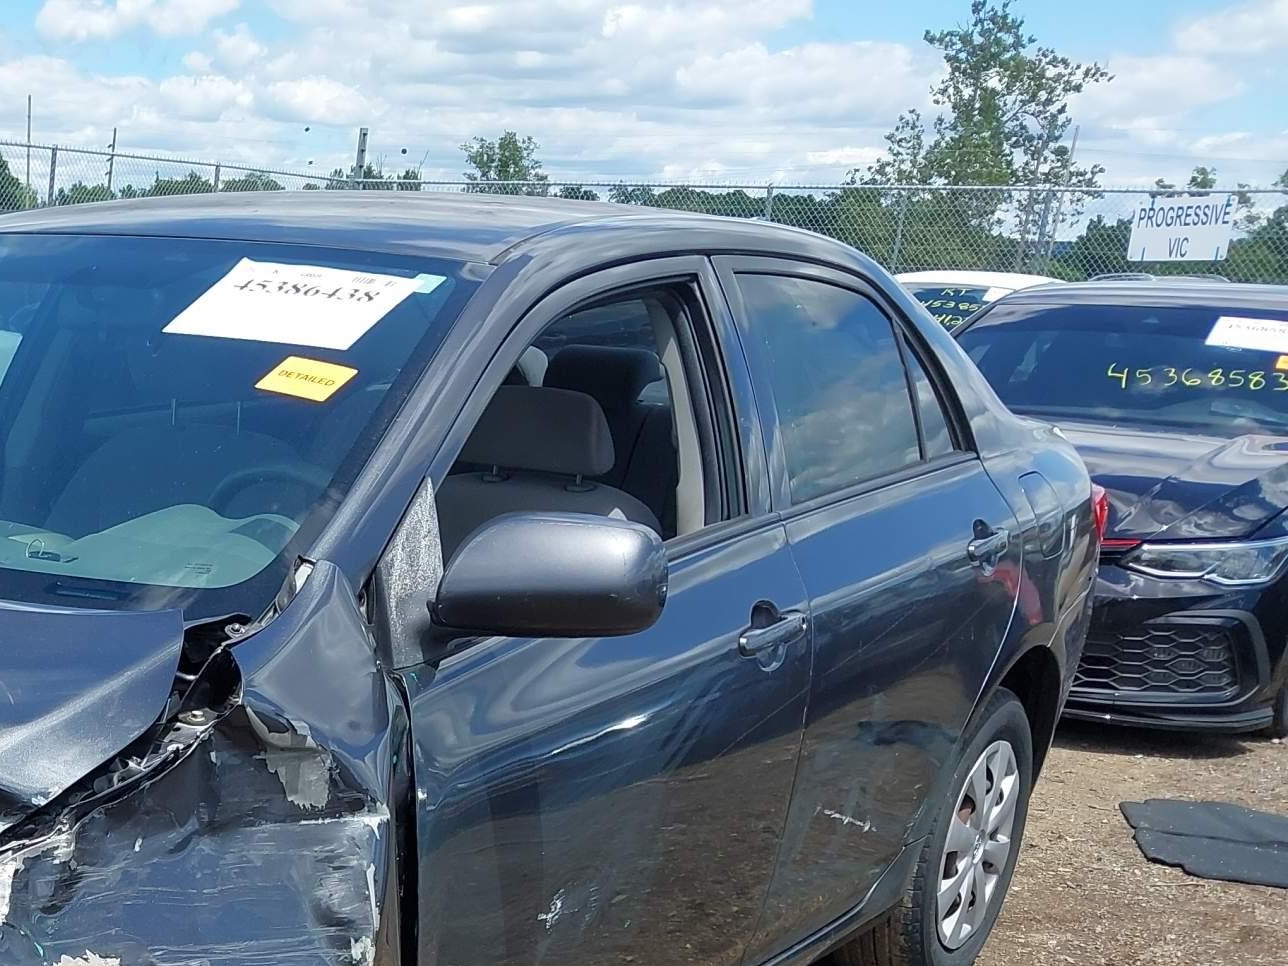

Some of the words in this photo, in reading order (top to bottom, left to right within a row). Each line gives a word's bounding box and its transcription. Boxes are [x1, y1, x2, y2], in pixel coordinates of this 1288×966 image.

[1137, 204, 1232, 228] PROGRESSIVE
[1168, 237, 1189, 258] VIC
[233, 279, 381, 303] 45386438
[277, 369, 336, 388] DETAILED
[1107, 361, 1288, 391] 45368583
